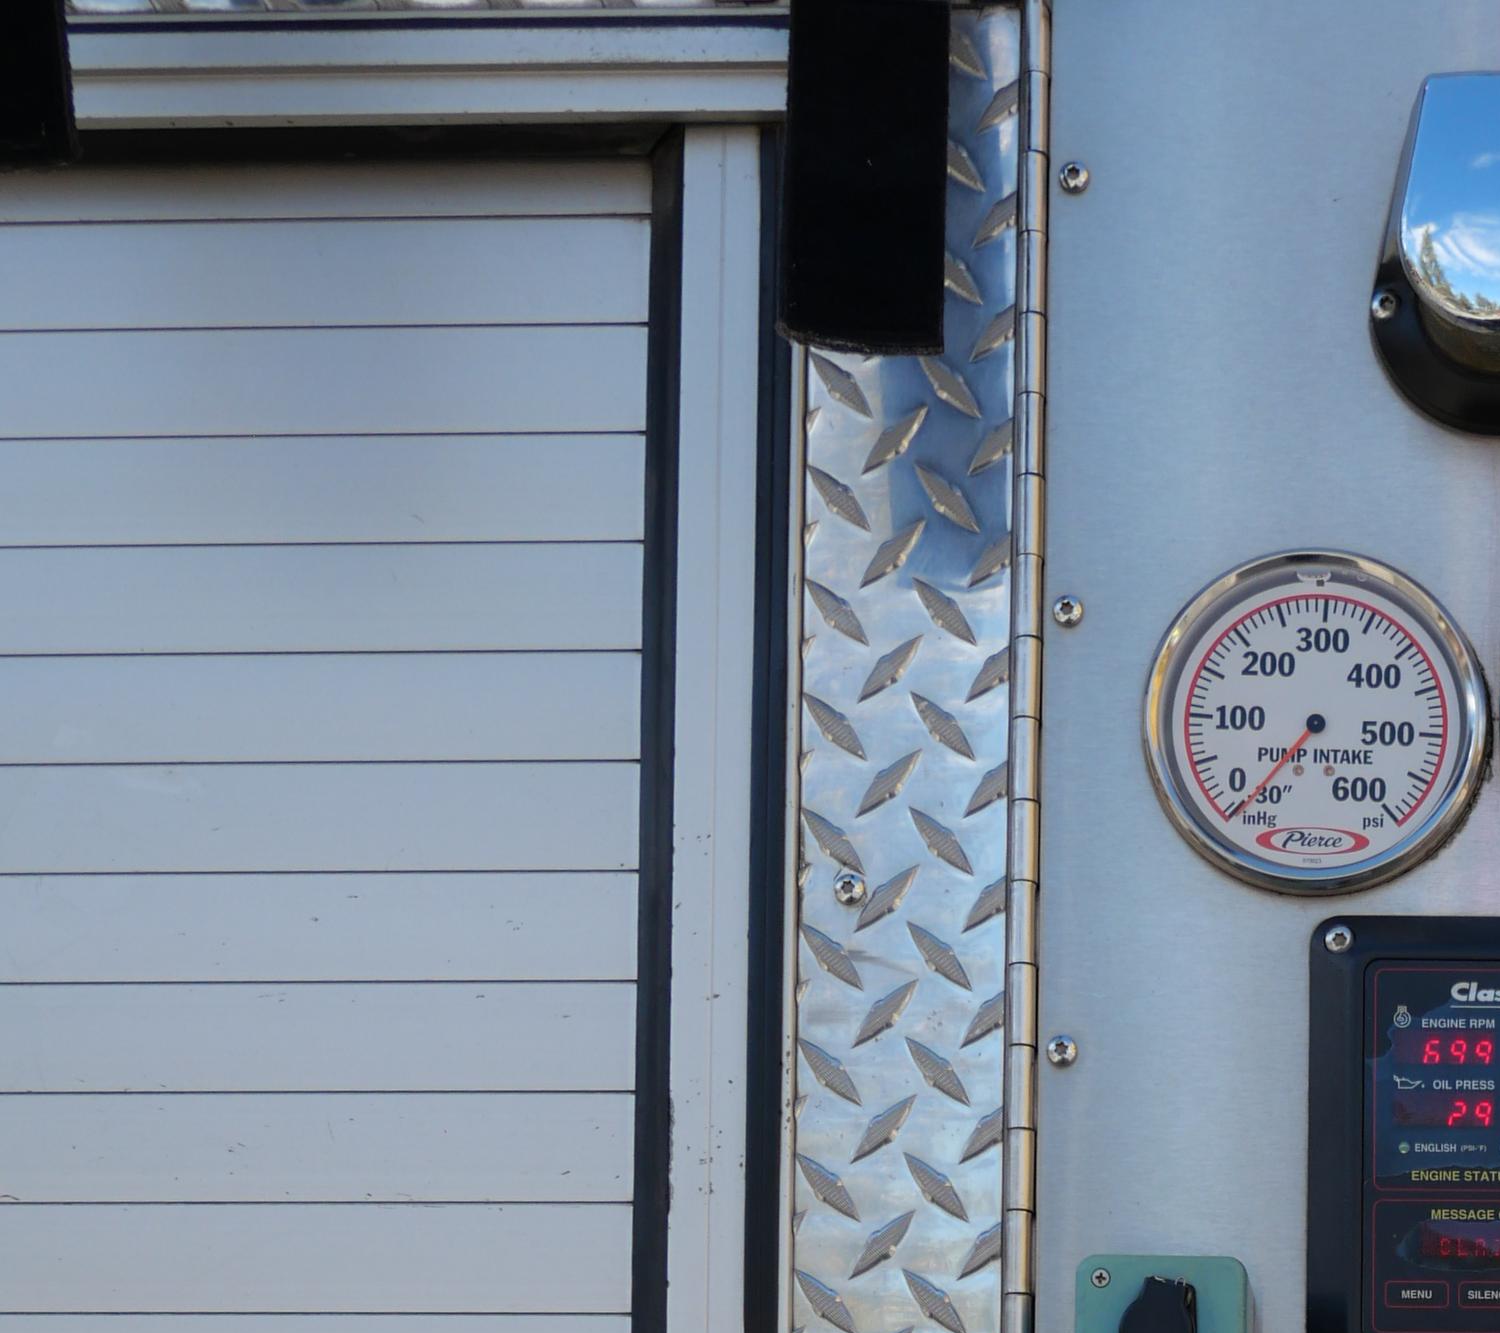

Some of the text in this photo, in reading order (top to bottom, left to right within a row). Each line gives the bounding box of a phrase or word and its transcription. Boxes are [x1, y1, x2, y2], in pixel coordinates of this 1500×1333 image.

[1295, 627, 1350, 653] 300
[1241, 651, 1296, 677] 200
[1347, 663, 1401, 689] 400
[1216, 705, 1265, 731] 100
[1361, 721, 1415, 747] 500
[1313, 748, 1373, 765] INTAKE
[1229, 767, 1247, 792] 0
[1332, 777, 1386, 802] 600
[1243, 811, 1277, 828] inHg
[1363, 814, 1384, 830] psi
[1282, 830, 1344, 849] Pierce
[1422, 1018, 1495, 1029] ENGINE RPM
[1433, 1079, 1495, 1091] OIL PRESS
[1415, 1143, 1456, 1154] ENGLISH
[1411, 1170, 1460, 1182] ENGINE
[1431, 1209, 1495, 1221] MESSAGE
[1401, 1290, 1432, 1300] MENU
